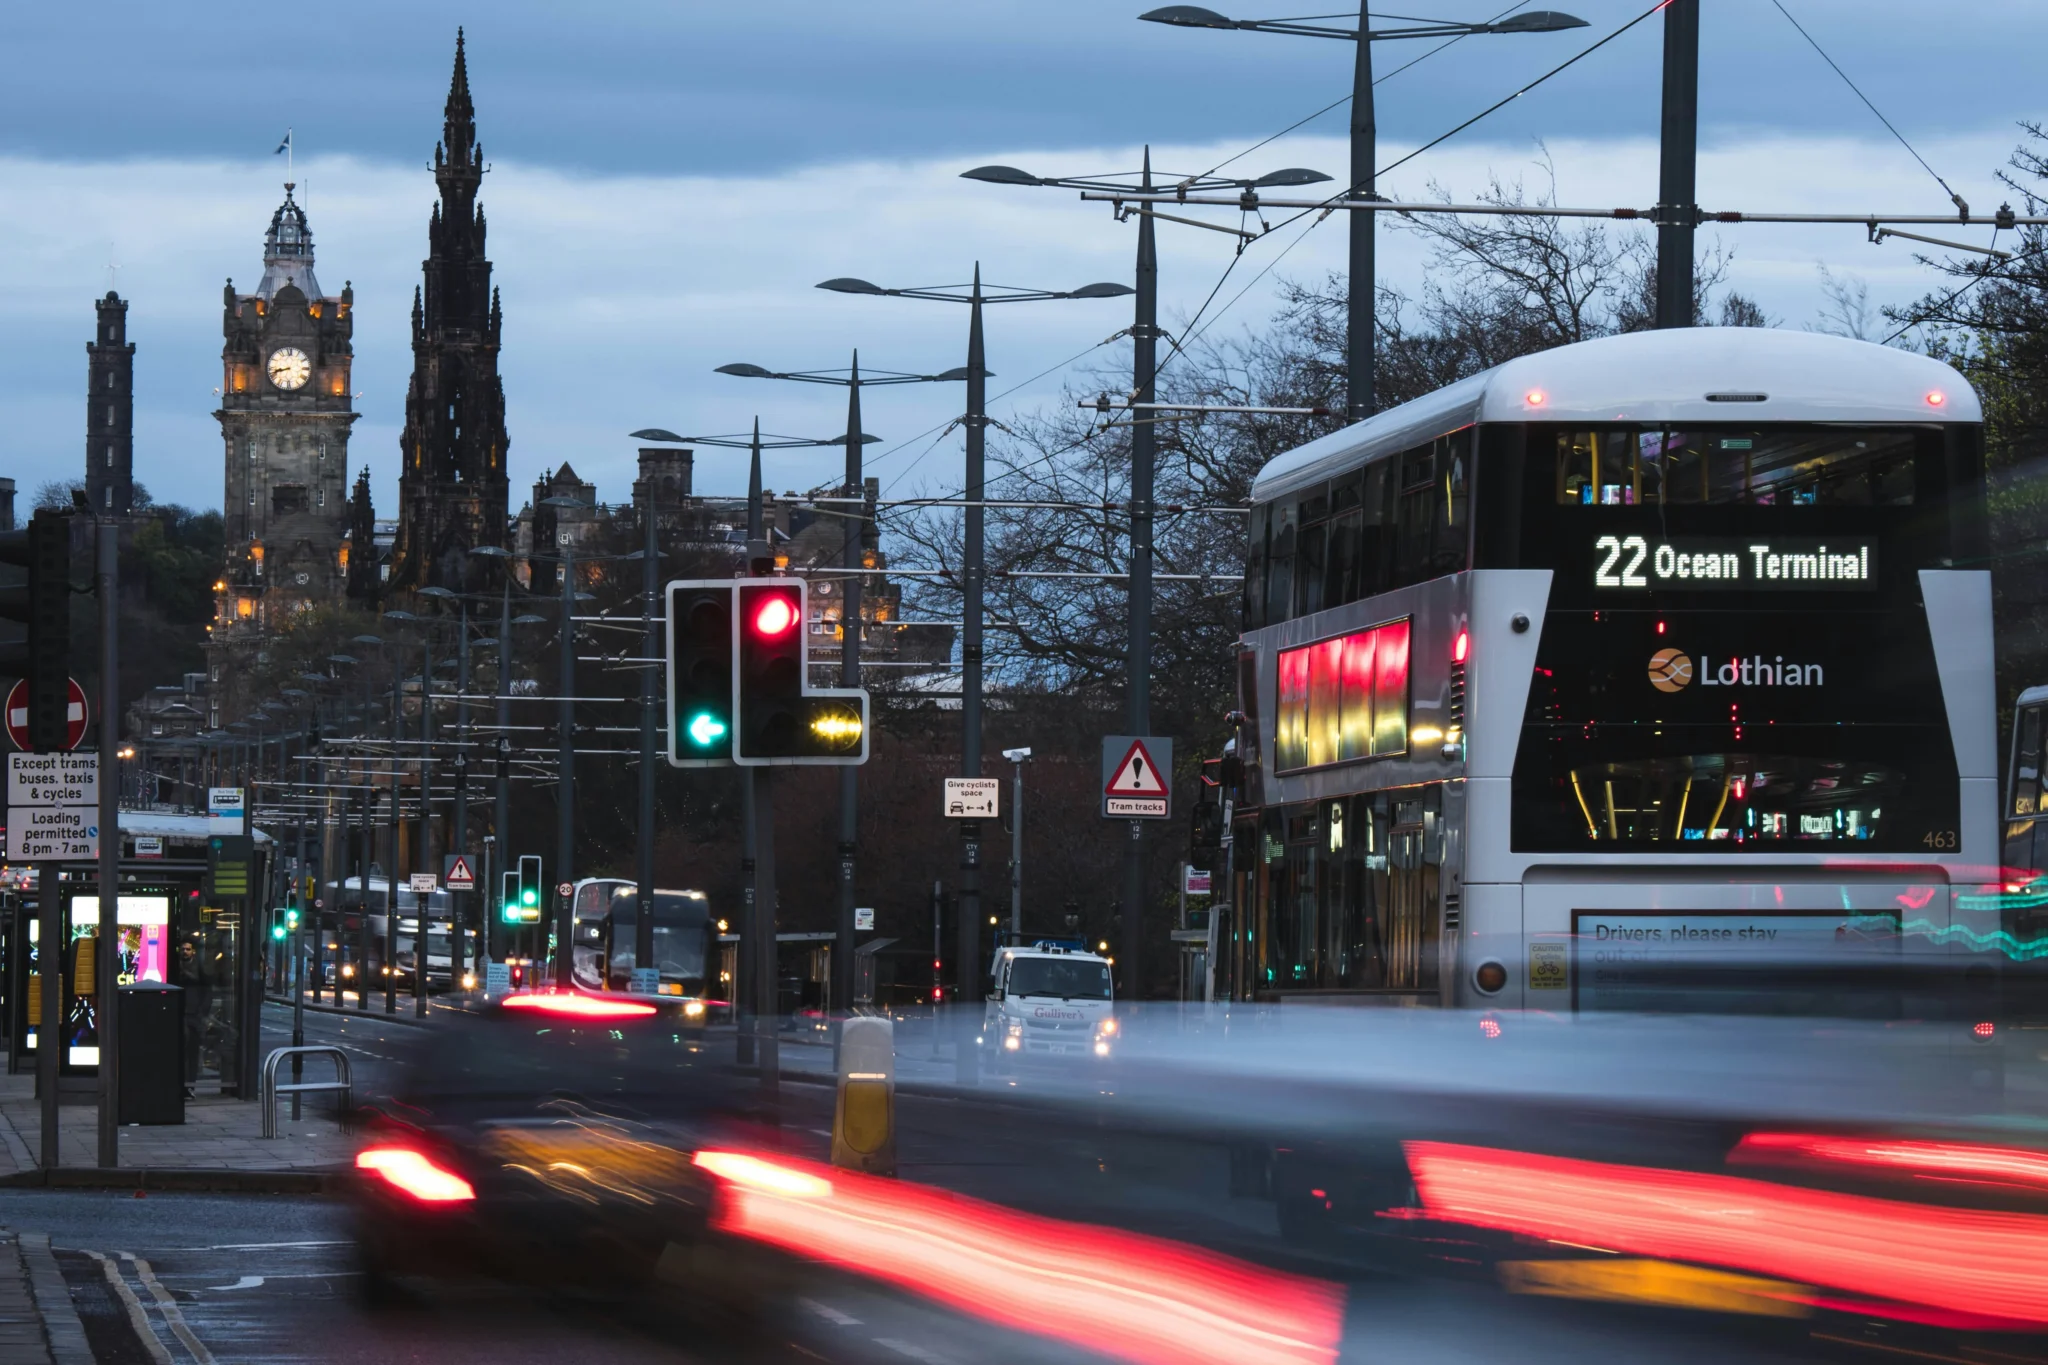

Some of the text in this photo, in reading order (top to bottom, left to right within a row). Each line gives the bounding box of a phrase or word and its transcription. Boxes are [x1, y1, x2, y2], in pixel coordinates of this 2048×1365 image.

[1596, 536, 1868, 586] 22 Ocean Terminal
[1701, 655, 1823, 686] Lothian
[13, 758, 56, 770] Except
[19, 772, 94, 785] buses, taxis
[966, 781, 996, 789] cyclists
[31, 787, 82, 801] & cycles
[1110, 802, 1163, 811] Tram tracks
[32, 813, 80, 826] Loading
[25, 827, 86, 841] permitted
[1923, 831, 1956, 848] 463
[1595, 924, 1667, 943] Drivers,
[1670, 924, 1732, 944] please
[1034, 1007, 1085, 1020] Gulliver's
